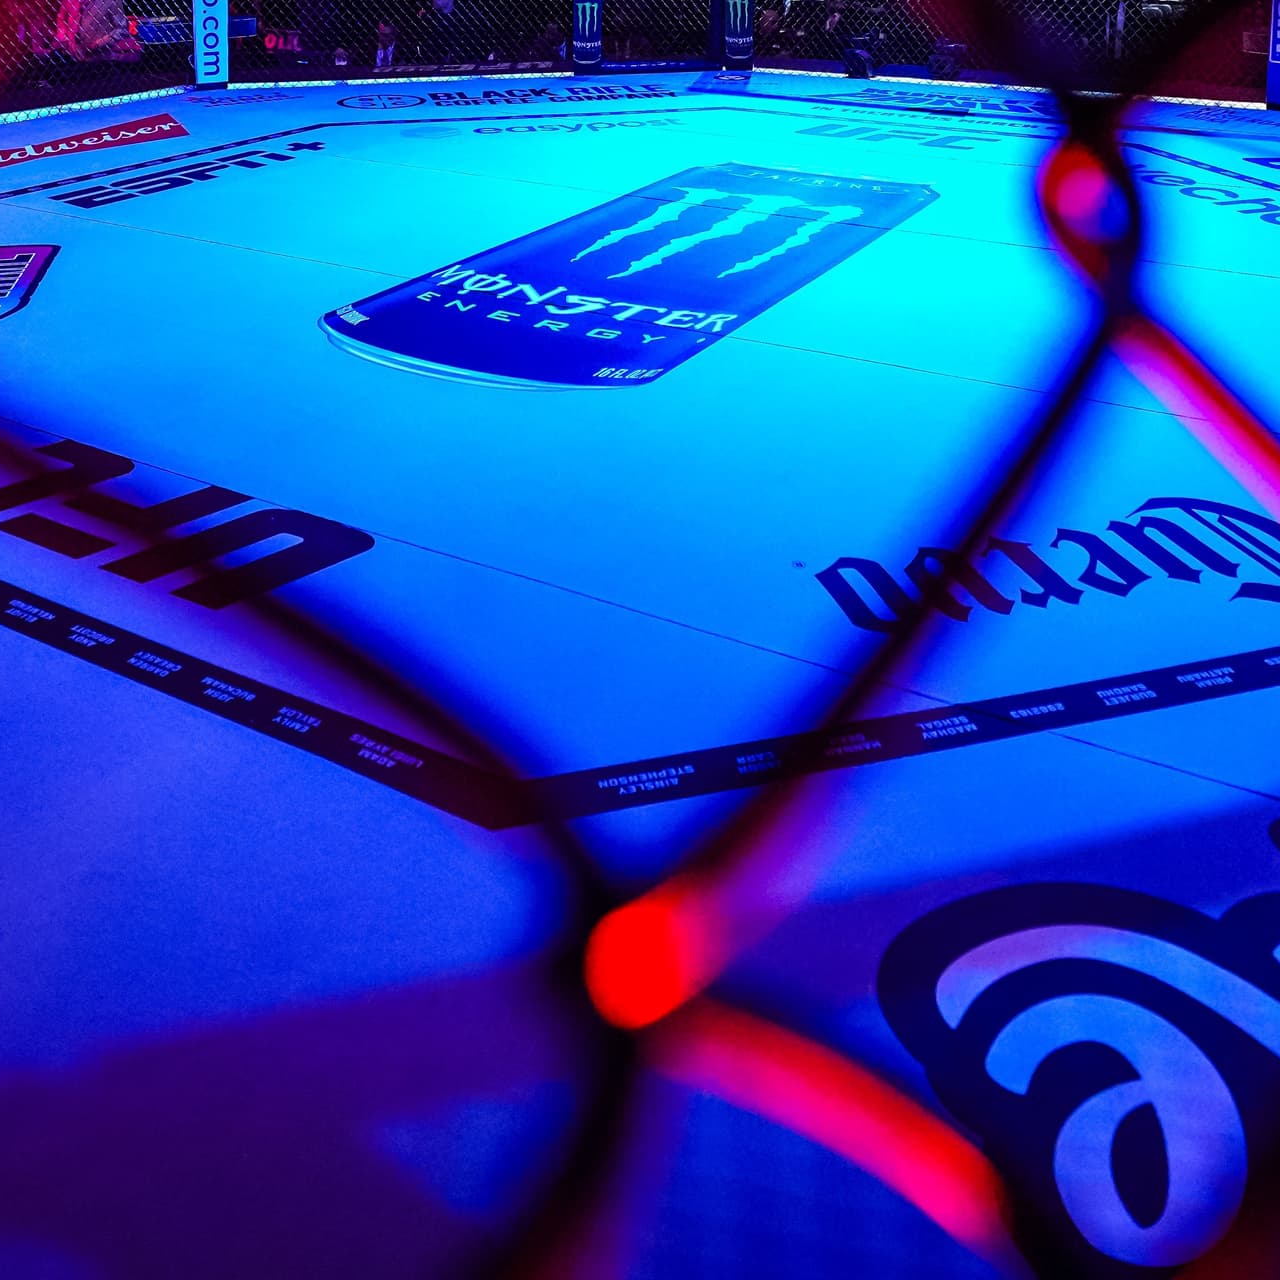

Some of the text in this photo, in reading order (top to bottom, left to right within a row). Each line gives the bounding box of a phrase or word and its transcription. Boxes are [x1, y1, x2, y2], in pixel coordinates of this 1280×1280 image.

[428, 84, 668, 101] BLACK RIFLE
[434, 91, 677, 107] COFFEE COMPANY
[473, 118, 690, 134] easypost
[794, 123, 1001, 150] UFC
[47, 142, 326, 210] ESPN+
[416, 291, 668, 344] ENERGY
[271, 714, 311, 734] EMILY
[277, 705, 323, 729] TAYLOR
[356, 748, 398, 769] ADAM
[596, 765, 696, 789] STEPHENSON
[618, 777, 680, 795] AINSLEY
